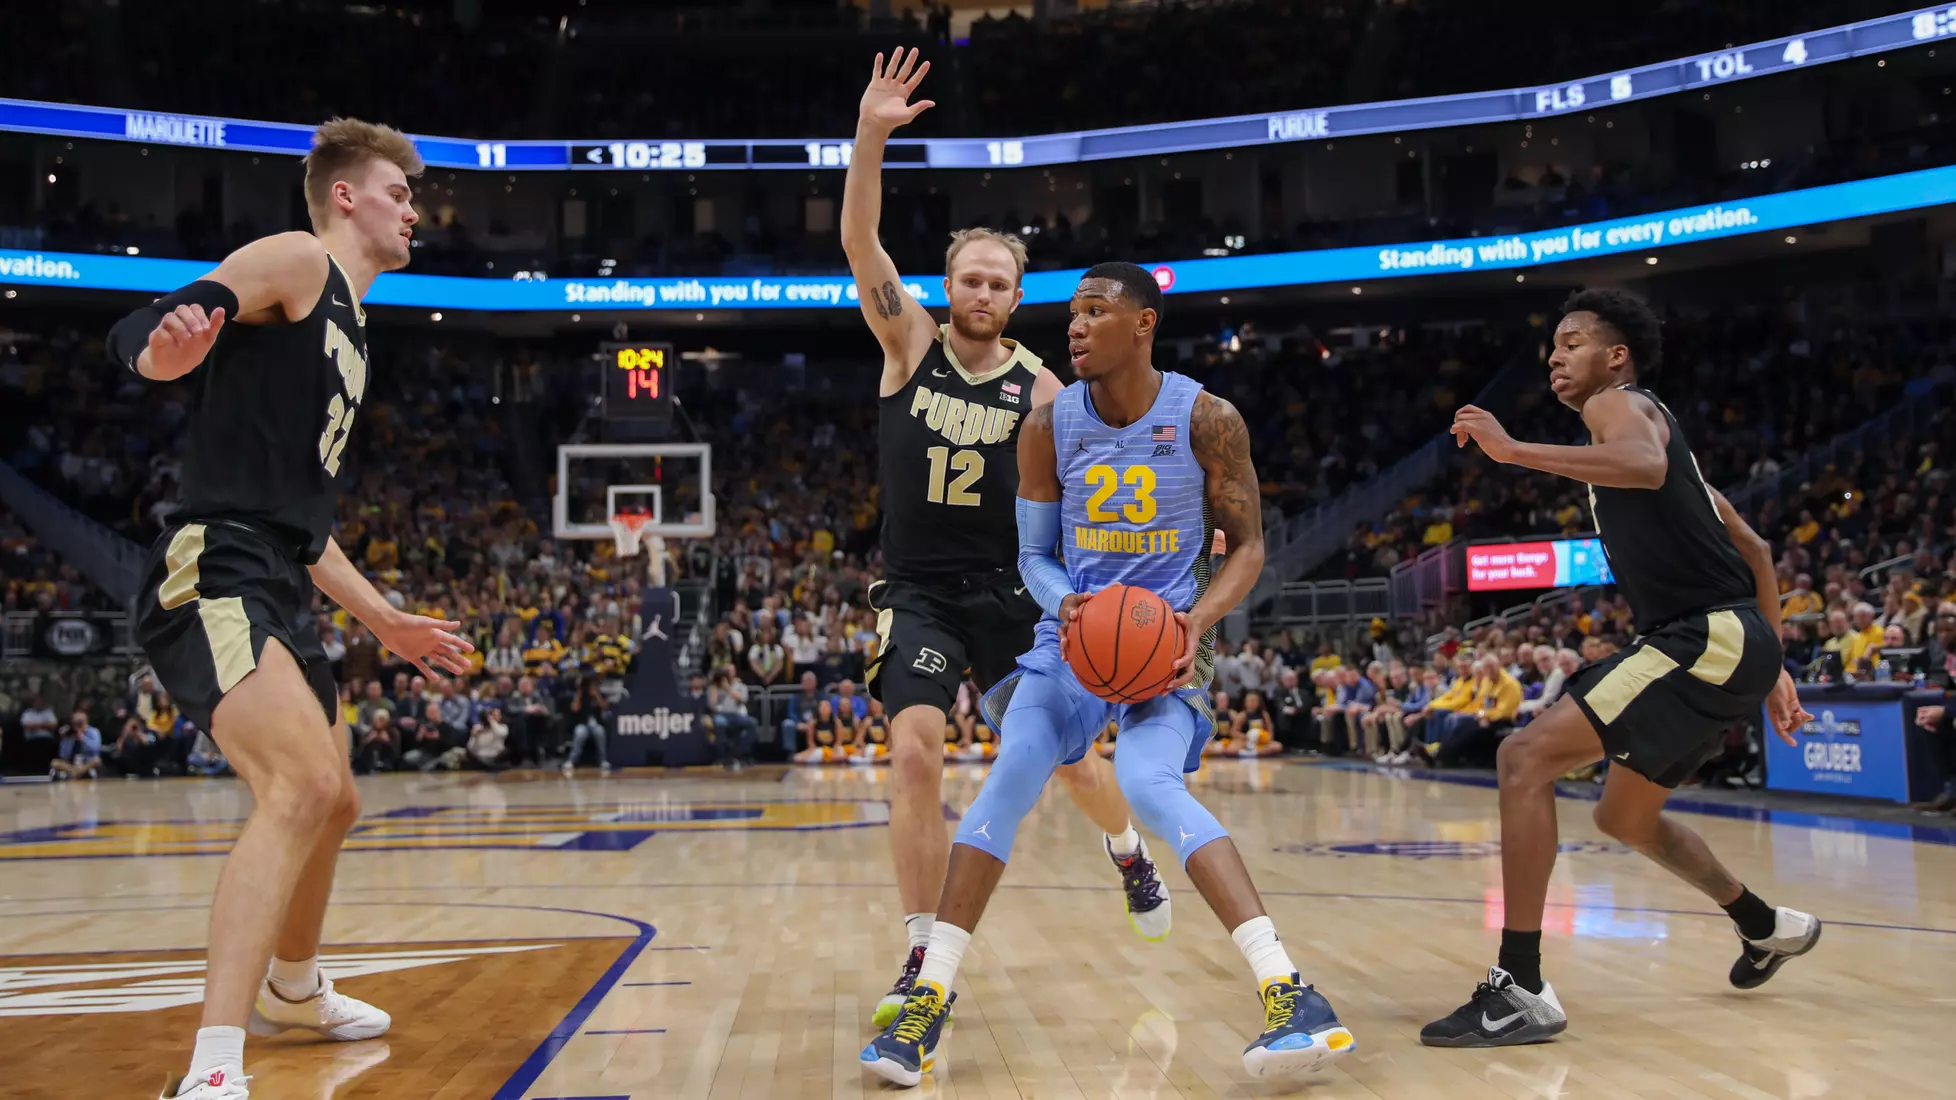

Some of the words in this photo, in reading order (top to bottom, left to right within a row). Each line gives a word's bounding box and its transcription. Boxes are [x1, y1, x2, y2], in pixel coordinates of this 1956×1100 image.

[1696, 52, 1753, 81] TOL
[1782, 38, 1807, 65] 4
[1536, 83, 1585, 113] FLS
[126, 113, 227, 147] MARQUETTE
[1268, 111, 1329, 140] PURDUE
[476, 143, 506, 168] 11
[609, 142, 706, 169] 10:25
[805, 142, 853, 166] 1st
[987, 140, 1024, 165] 15
[1379, 243, 1474, 270] Standing
[1478, 237, 1528, 263] with
[1531, 235, 1569, 262] you
[1572, 228, 1601, 251] for
[1606, 220, 1665, 244] every
[1668, 206, 1758, 236] ovation.
[565, 280, 655, 306] Standing
[660, 280, 706, 301] with
[710, 284, 749, 306] you
[752, 279, 781, 300] for
[785, 283, 843, 305] every
[617, 348, 664, 370] 10:24
[628, 369, 659, 399] 14
[910, 385, 1020, 446] PURDUE
[319, 393, 355, 478] 32
[1151, 449, 1176, 457] EAST
[927, 446, 985, 506] 12
[1085, 465, 1158, 524] 23
[1075, 526, 1180, 554] MARQUETTE
[617, 706, 695, 740] meijer
[1803, 741, 1862, 773] GRUBER
